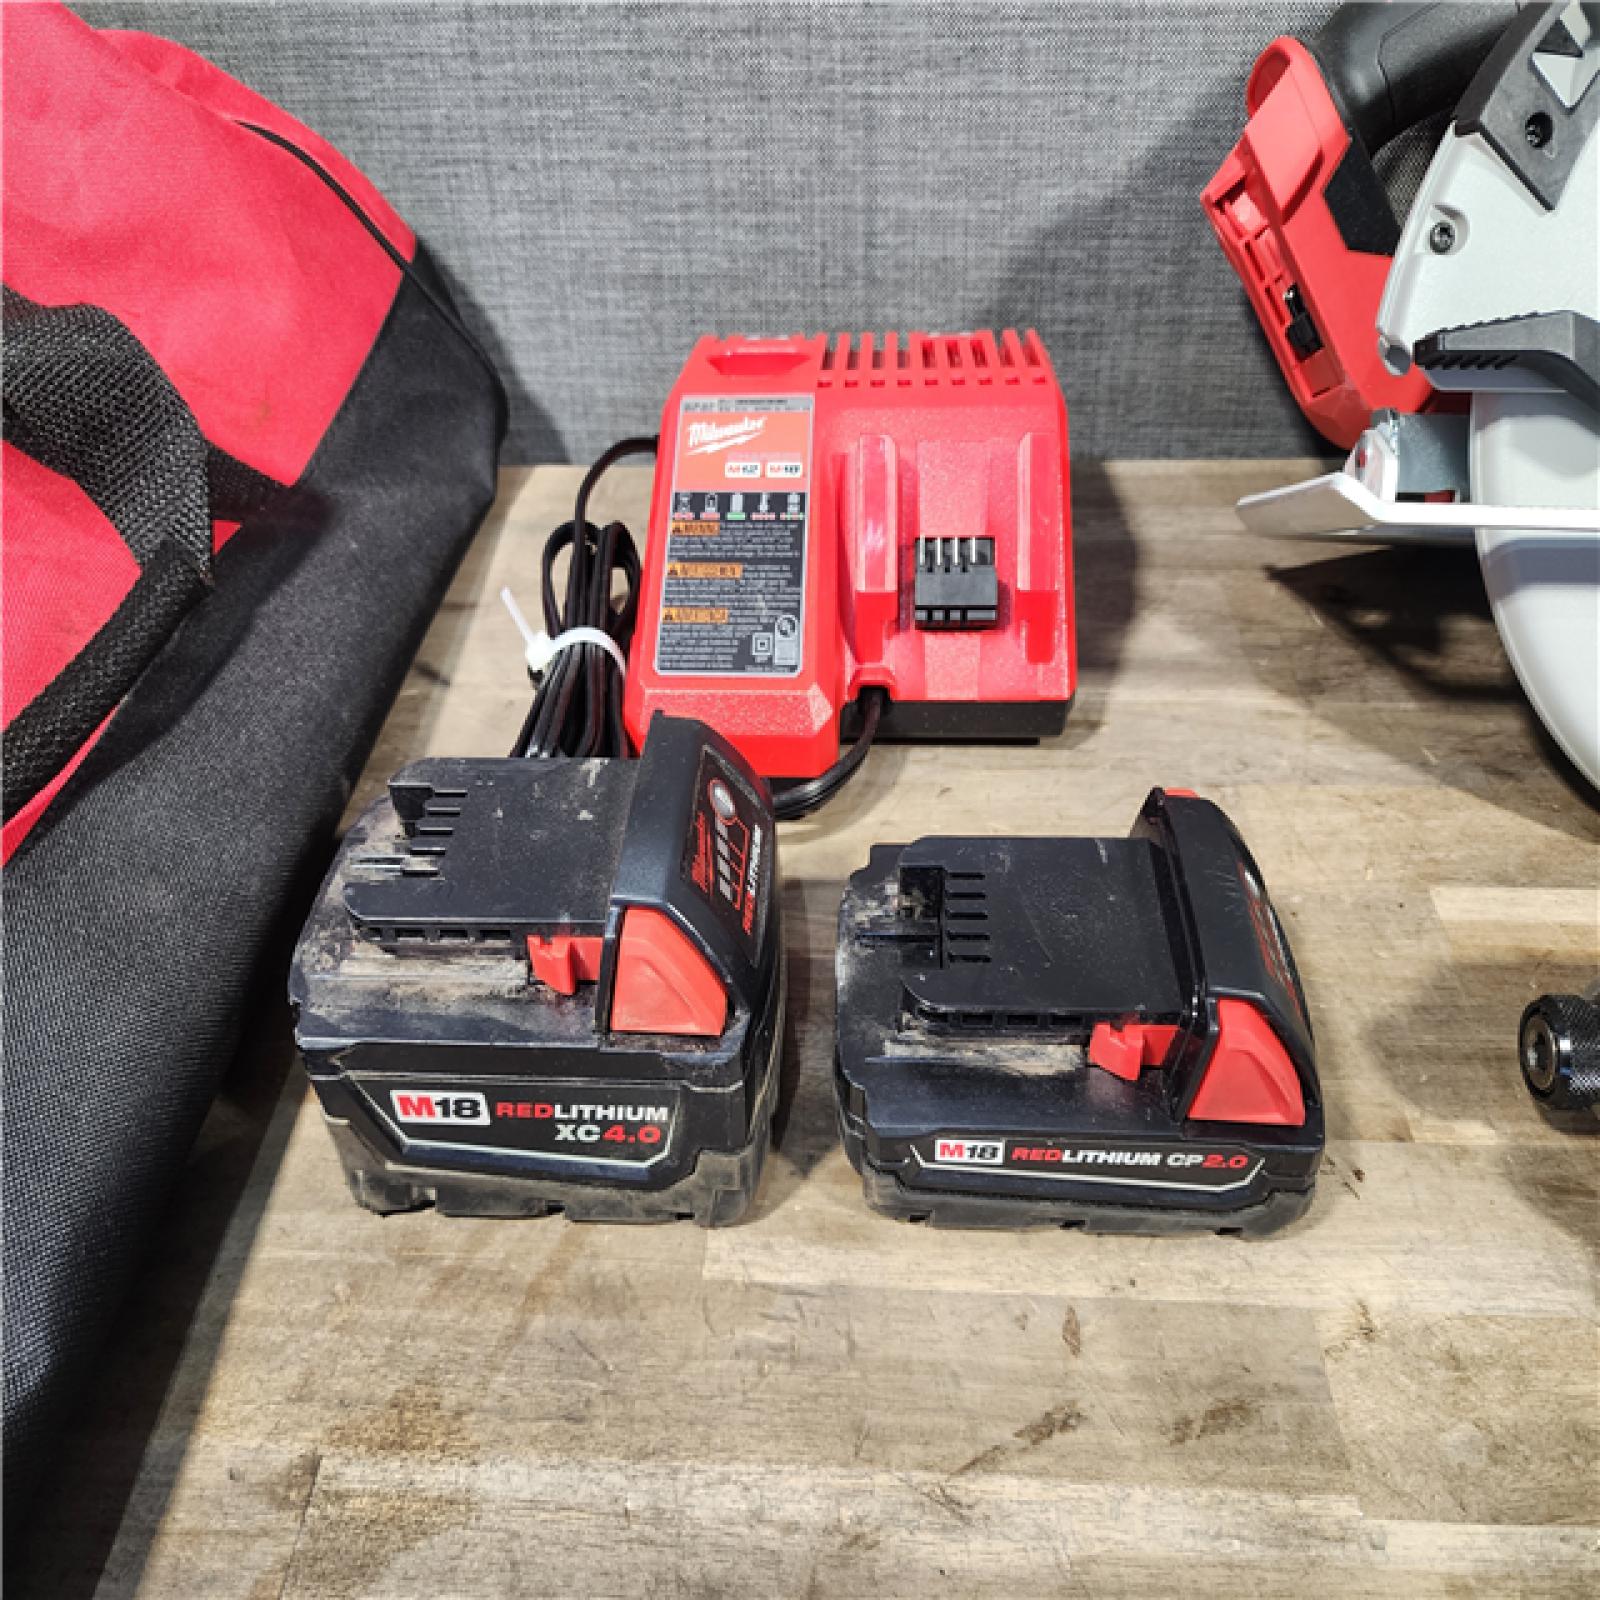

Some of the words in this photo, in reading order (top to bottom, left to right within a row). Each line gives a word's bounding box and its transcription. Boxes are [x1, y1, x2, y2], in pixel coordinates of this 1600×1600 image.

[396, 1094, 482, 1118] M18
[495, 1101, 668, 1121] REDLITHIUM
[939, 1144, 1000, 1160] M18
[1011, 1147, 1161, 1166] REDLITHIUM
